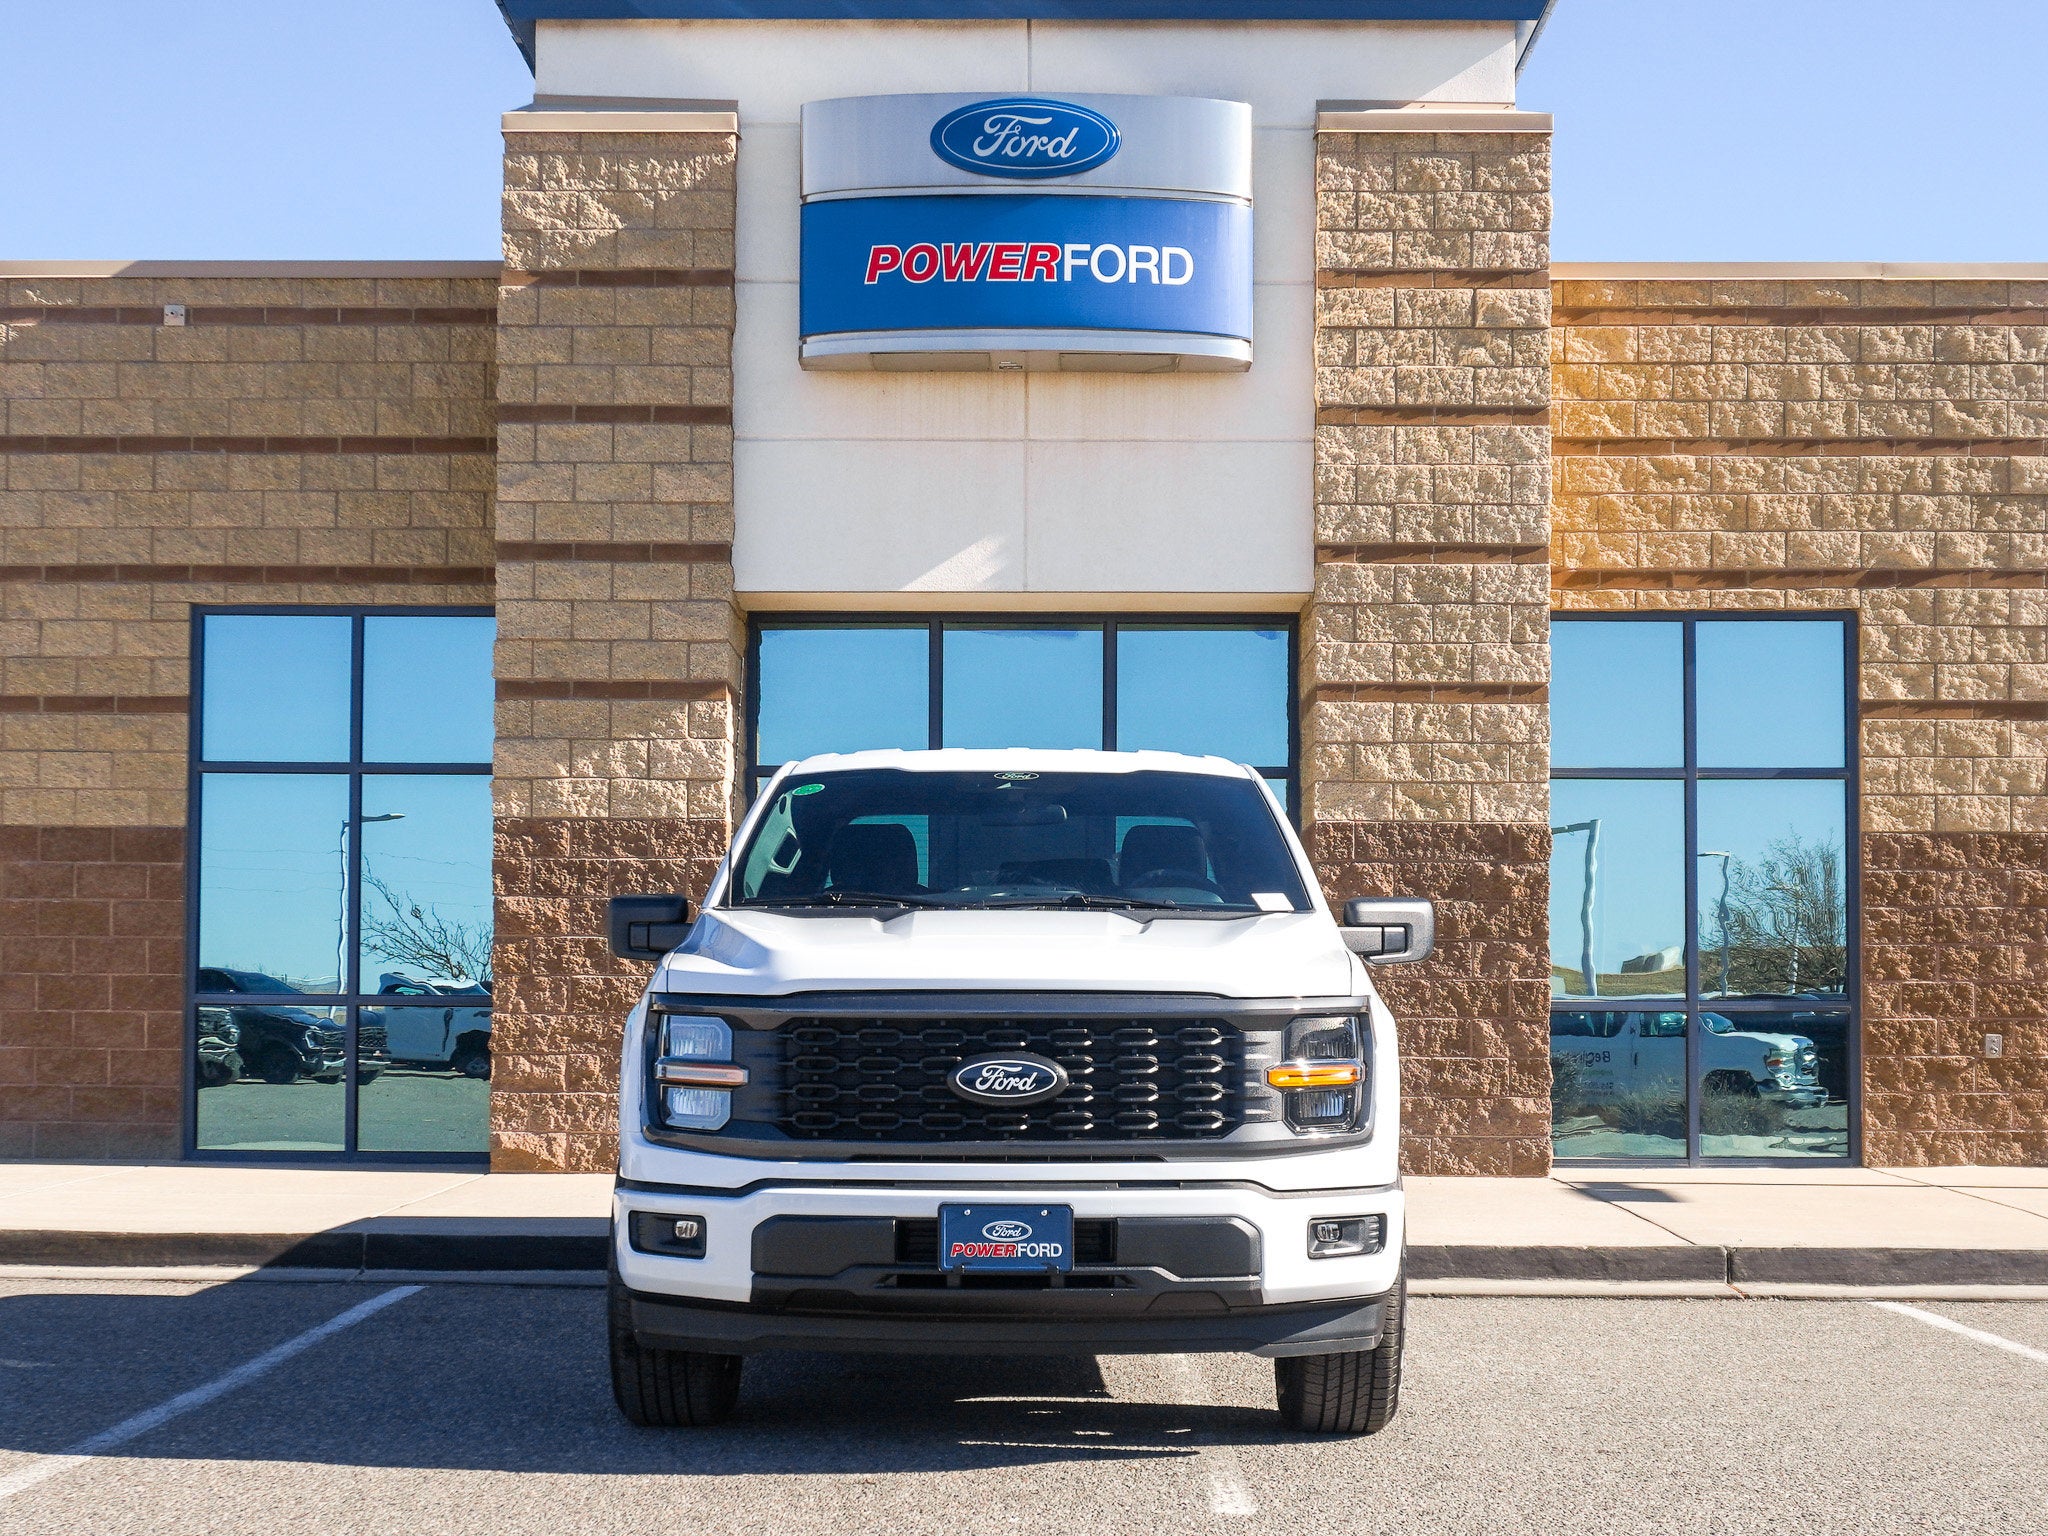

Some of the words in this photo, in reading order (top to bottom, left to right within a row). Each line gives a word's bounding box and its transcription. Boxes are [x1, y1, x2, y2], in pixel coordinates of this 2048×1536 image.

[972, 114, 1078, 159] Ford
[864, 242, 1195, 286] POWERFORD
[975, 1064, 1038, 1091] Ford
[992, 1223, 1023, 1237] Ford
[950, 1243, 1063, 1258] POWERFORD
